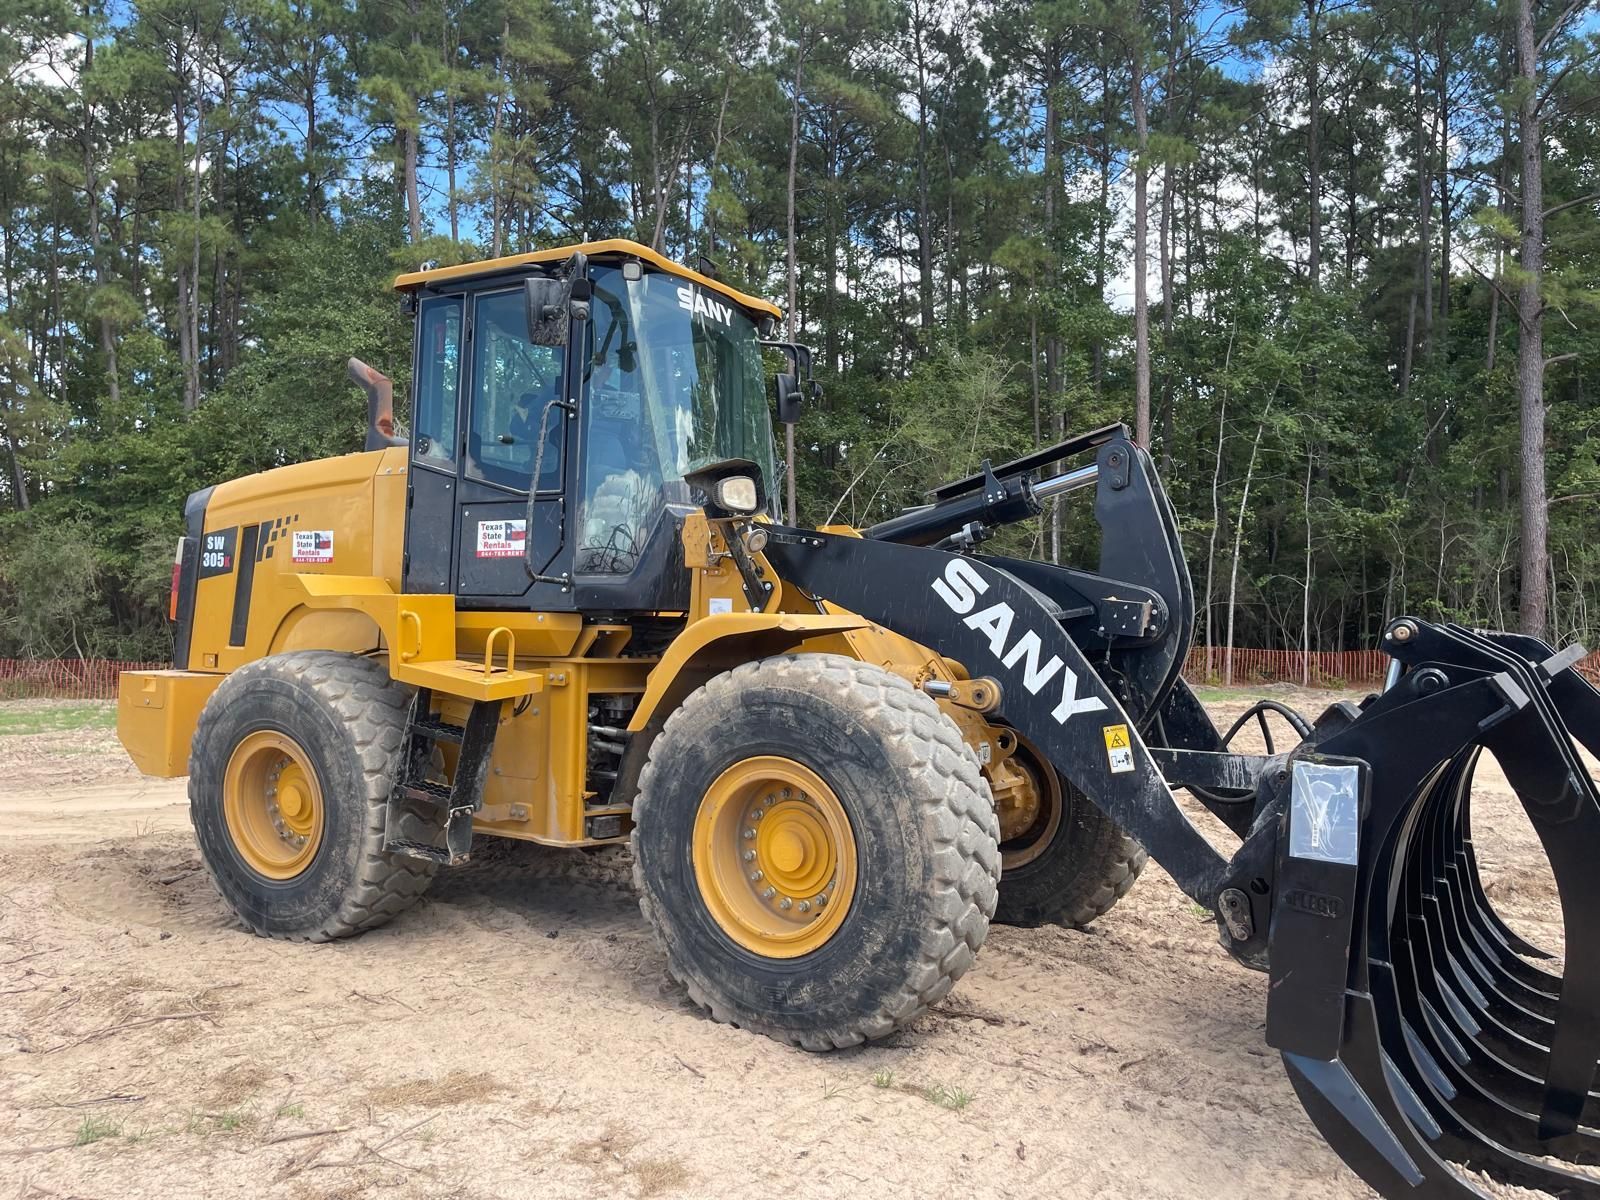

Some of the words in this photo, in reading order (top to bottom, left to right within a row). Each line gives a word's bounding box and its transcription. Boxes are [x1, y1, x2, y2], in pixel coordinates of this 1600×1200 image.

[677, 286, 732, 327] SANY
[481, 523, 503, 531] Texas
[482, 532, 502, 540] State
[207, 536, 225, 550] SW
[483, 541, 512, 549] Rentals
[931, 558, 1108, 725] SANY
